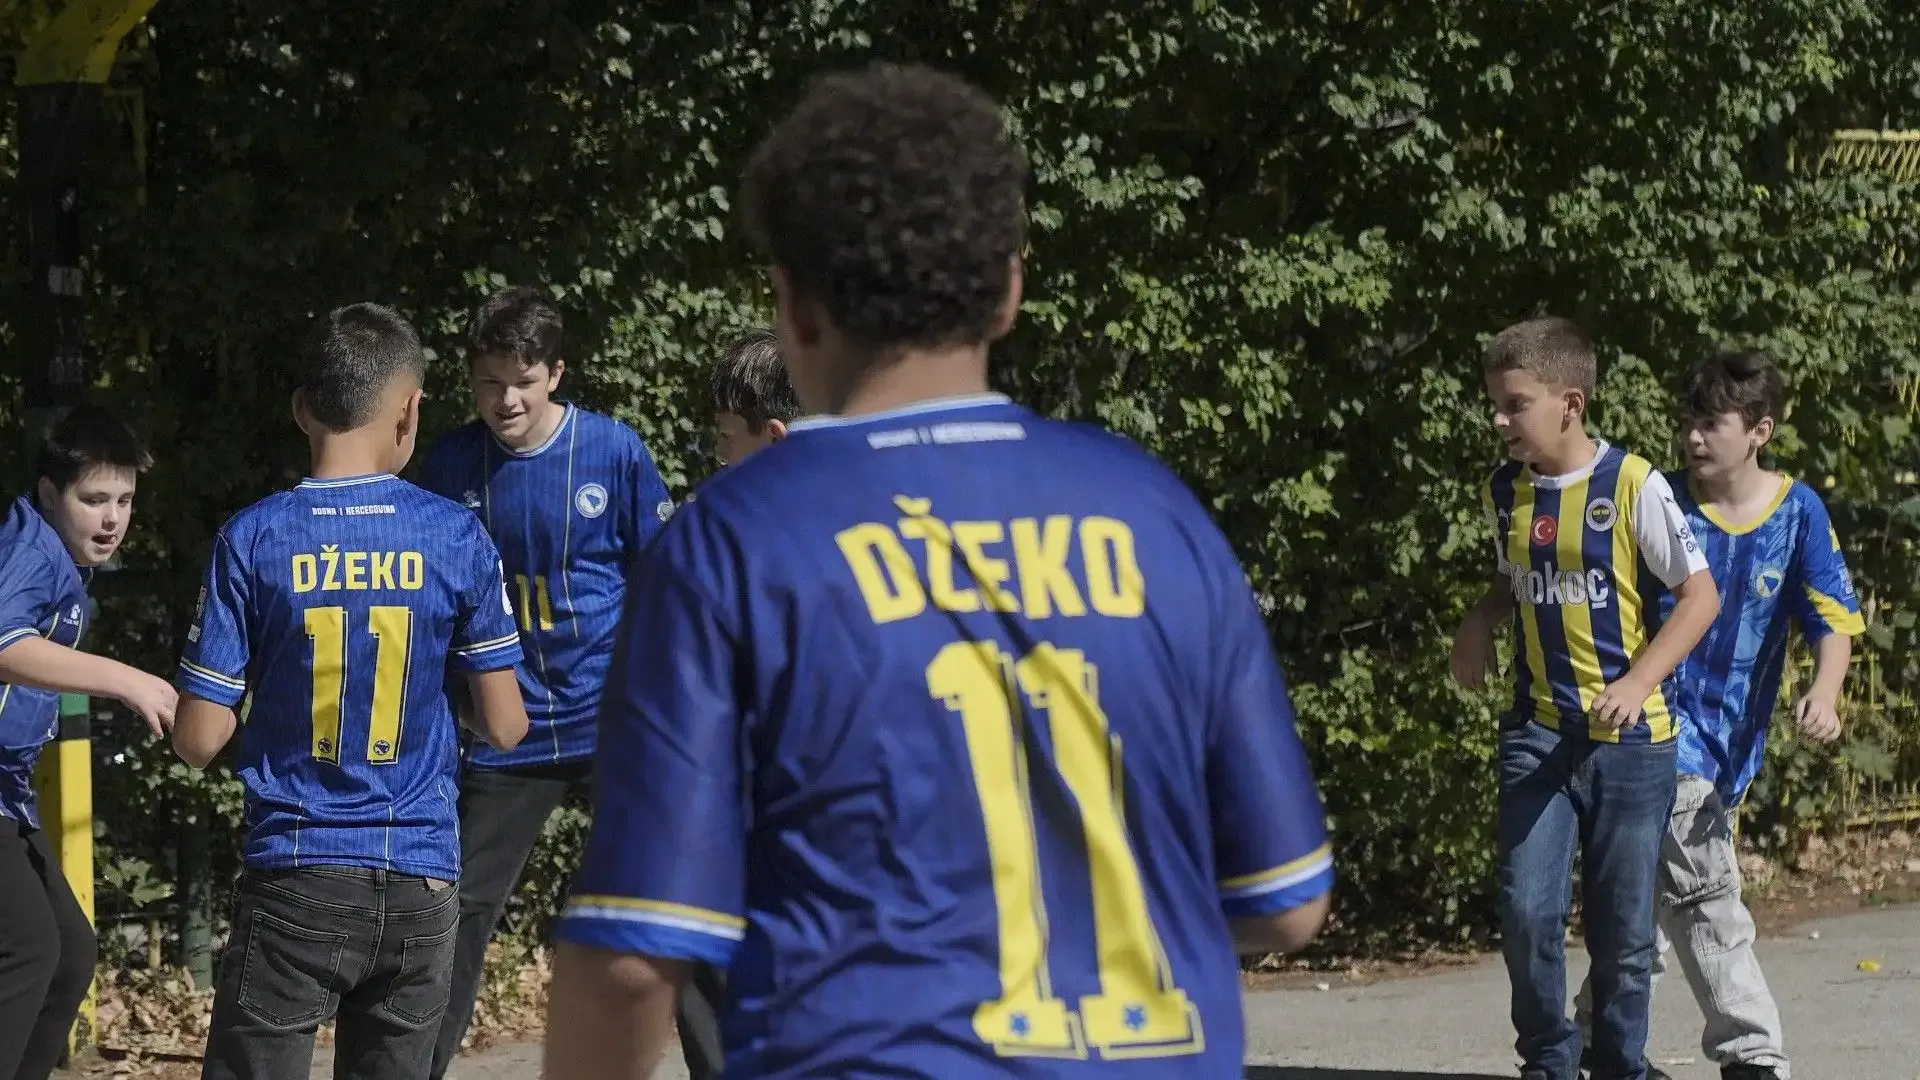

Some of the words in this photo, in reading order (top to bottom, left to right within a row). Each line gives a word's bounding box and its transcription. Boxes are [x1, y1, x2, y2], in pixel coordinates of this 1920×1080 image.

[312, 507, 337, 516] BOSNA
[292, 544, 424, 593] DŽEKO
[835, 494, 1145, 624] DŽEKO
[1511, 560, 1609, 610] tokoç
[516, 575, 554, 632] 11
[304, 606, 414, 767] 11
[926, 640, 1205, 1060] 11
